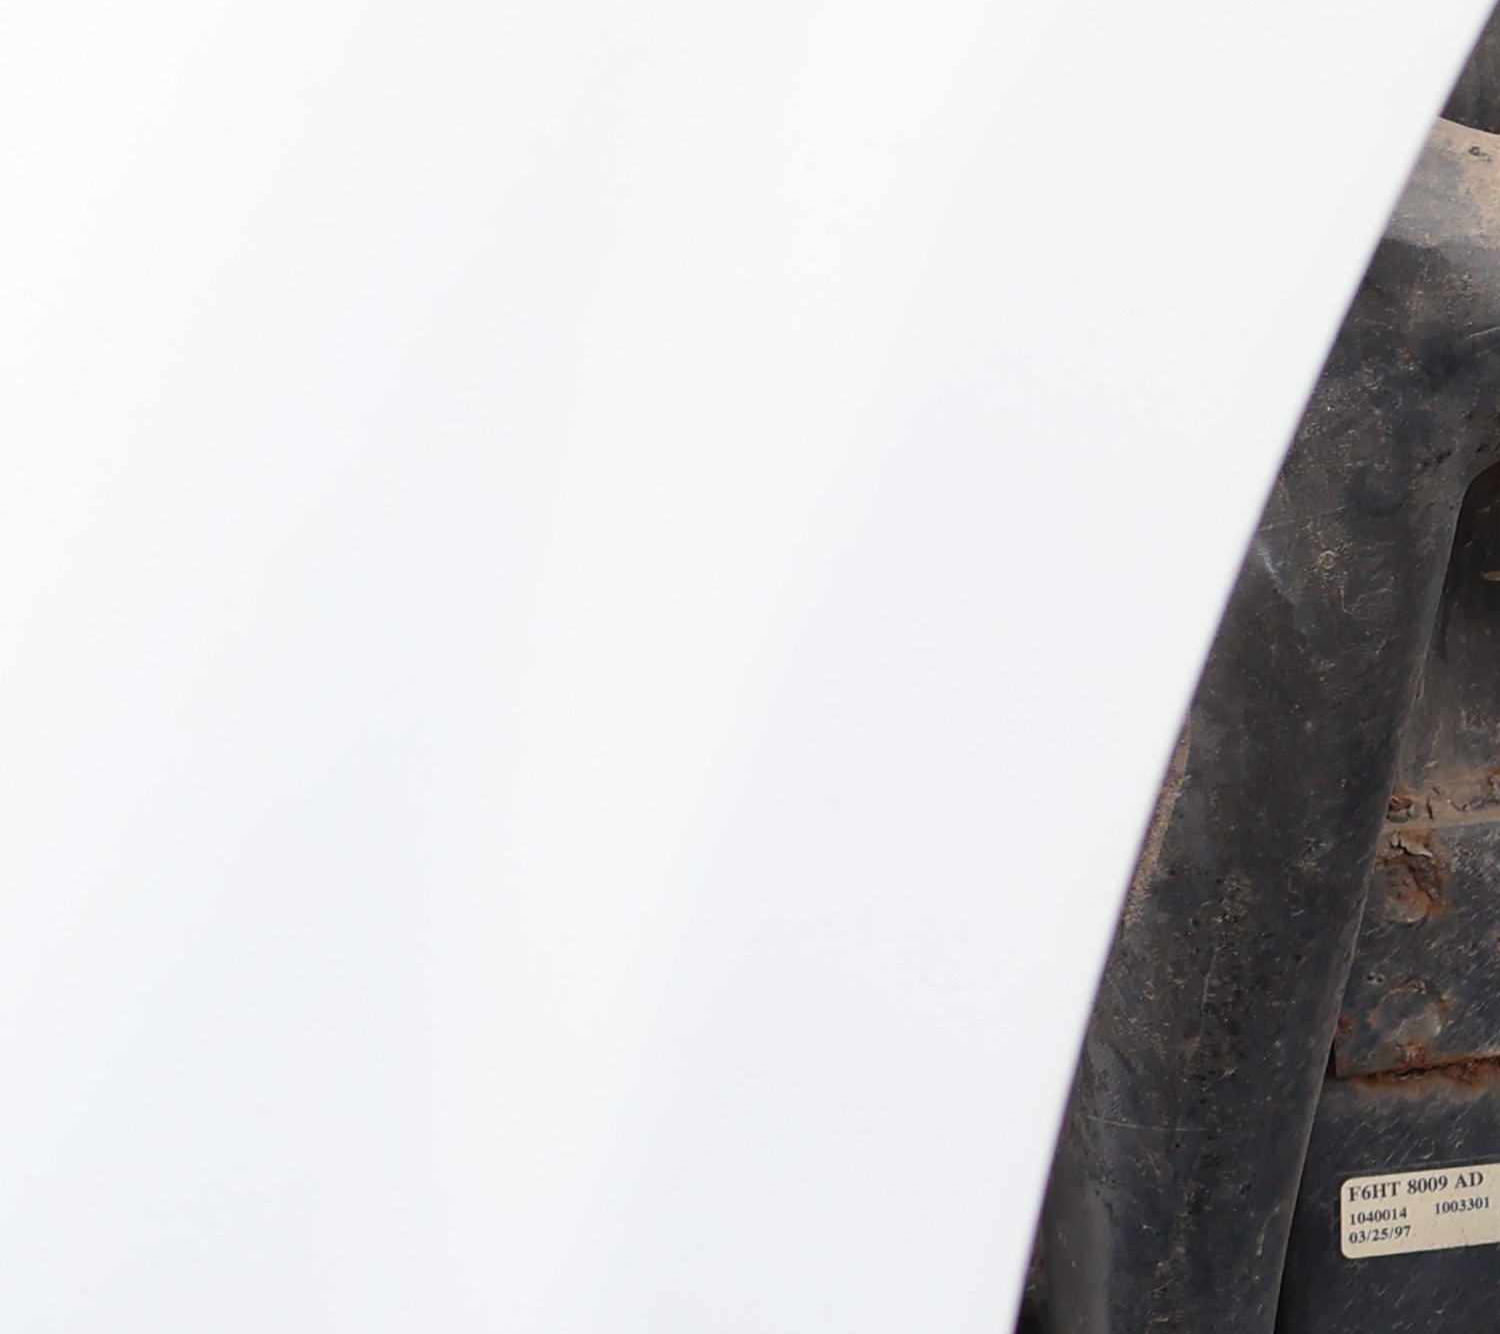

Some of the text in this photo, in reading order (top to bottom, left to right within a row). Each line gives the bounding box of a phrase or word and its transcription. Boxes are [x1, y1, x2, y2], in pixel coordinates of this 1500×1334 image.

[1349, 1181, 1401, 1203] F6HT
[1407, 1175, 1448, 1195] 8009
[1454, 1171, 1484, 1190] AD
[1349, 1207, 1408, 1226] 1040014
[1434, 1197, 1491, 1215] 1003301
[1349, 1225, 1412, 1244] 03/25/97
